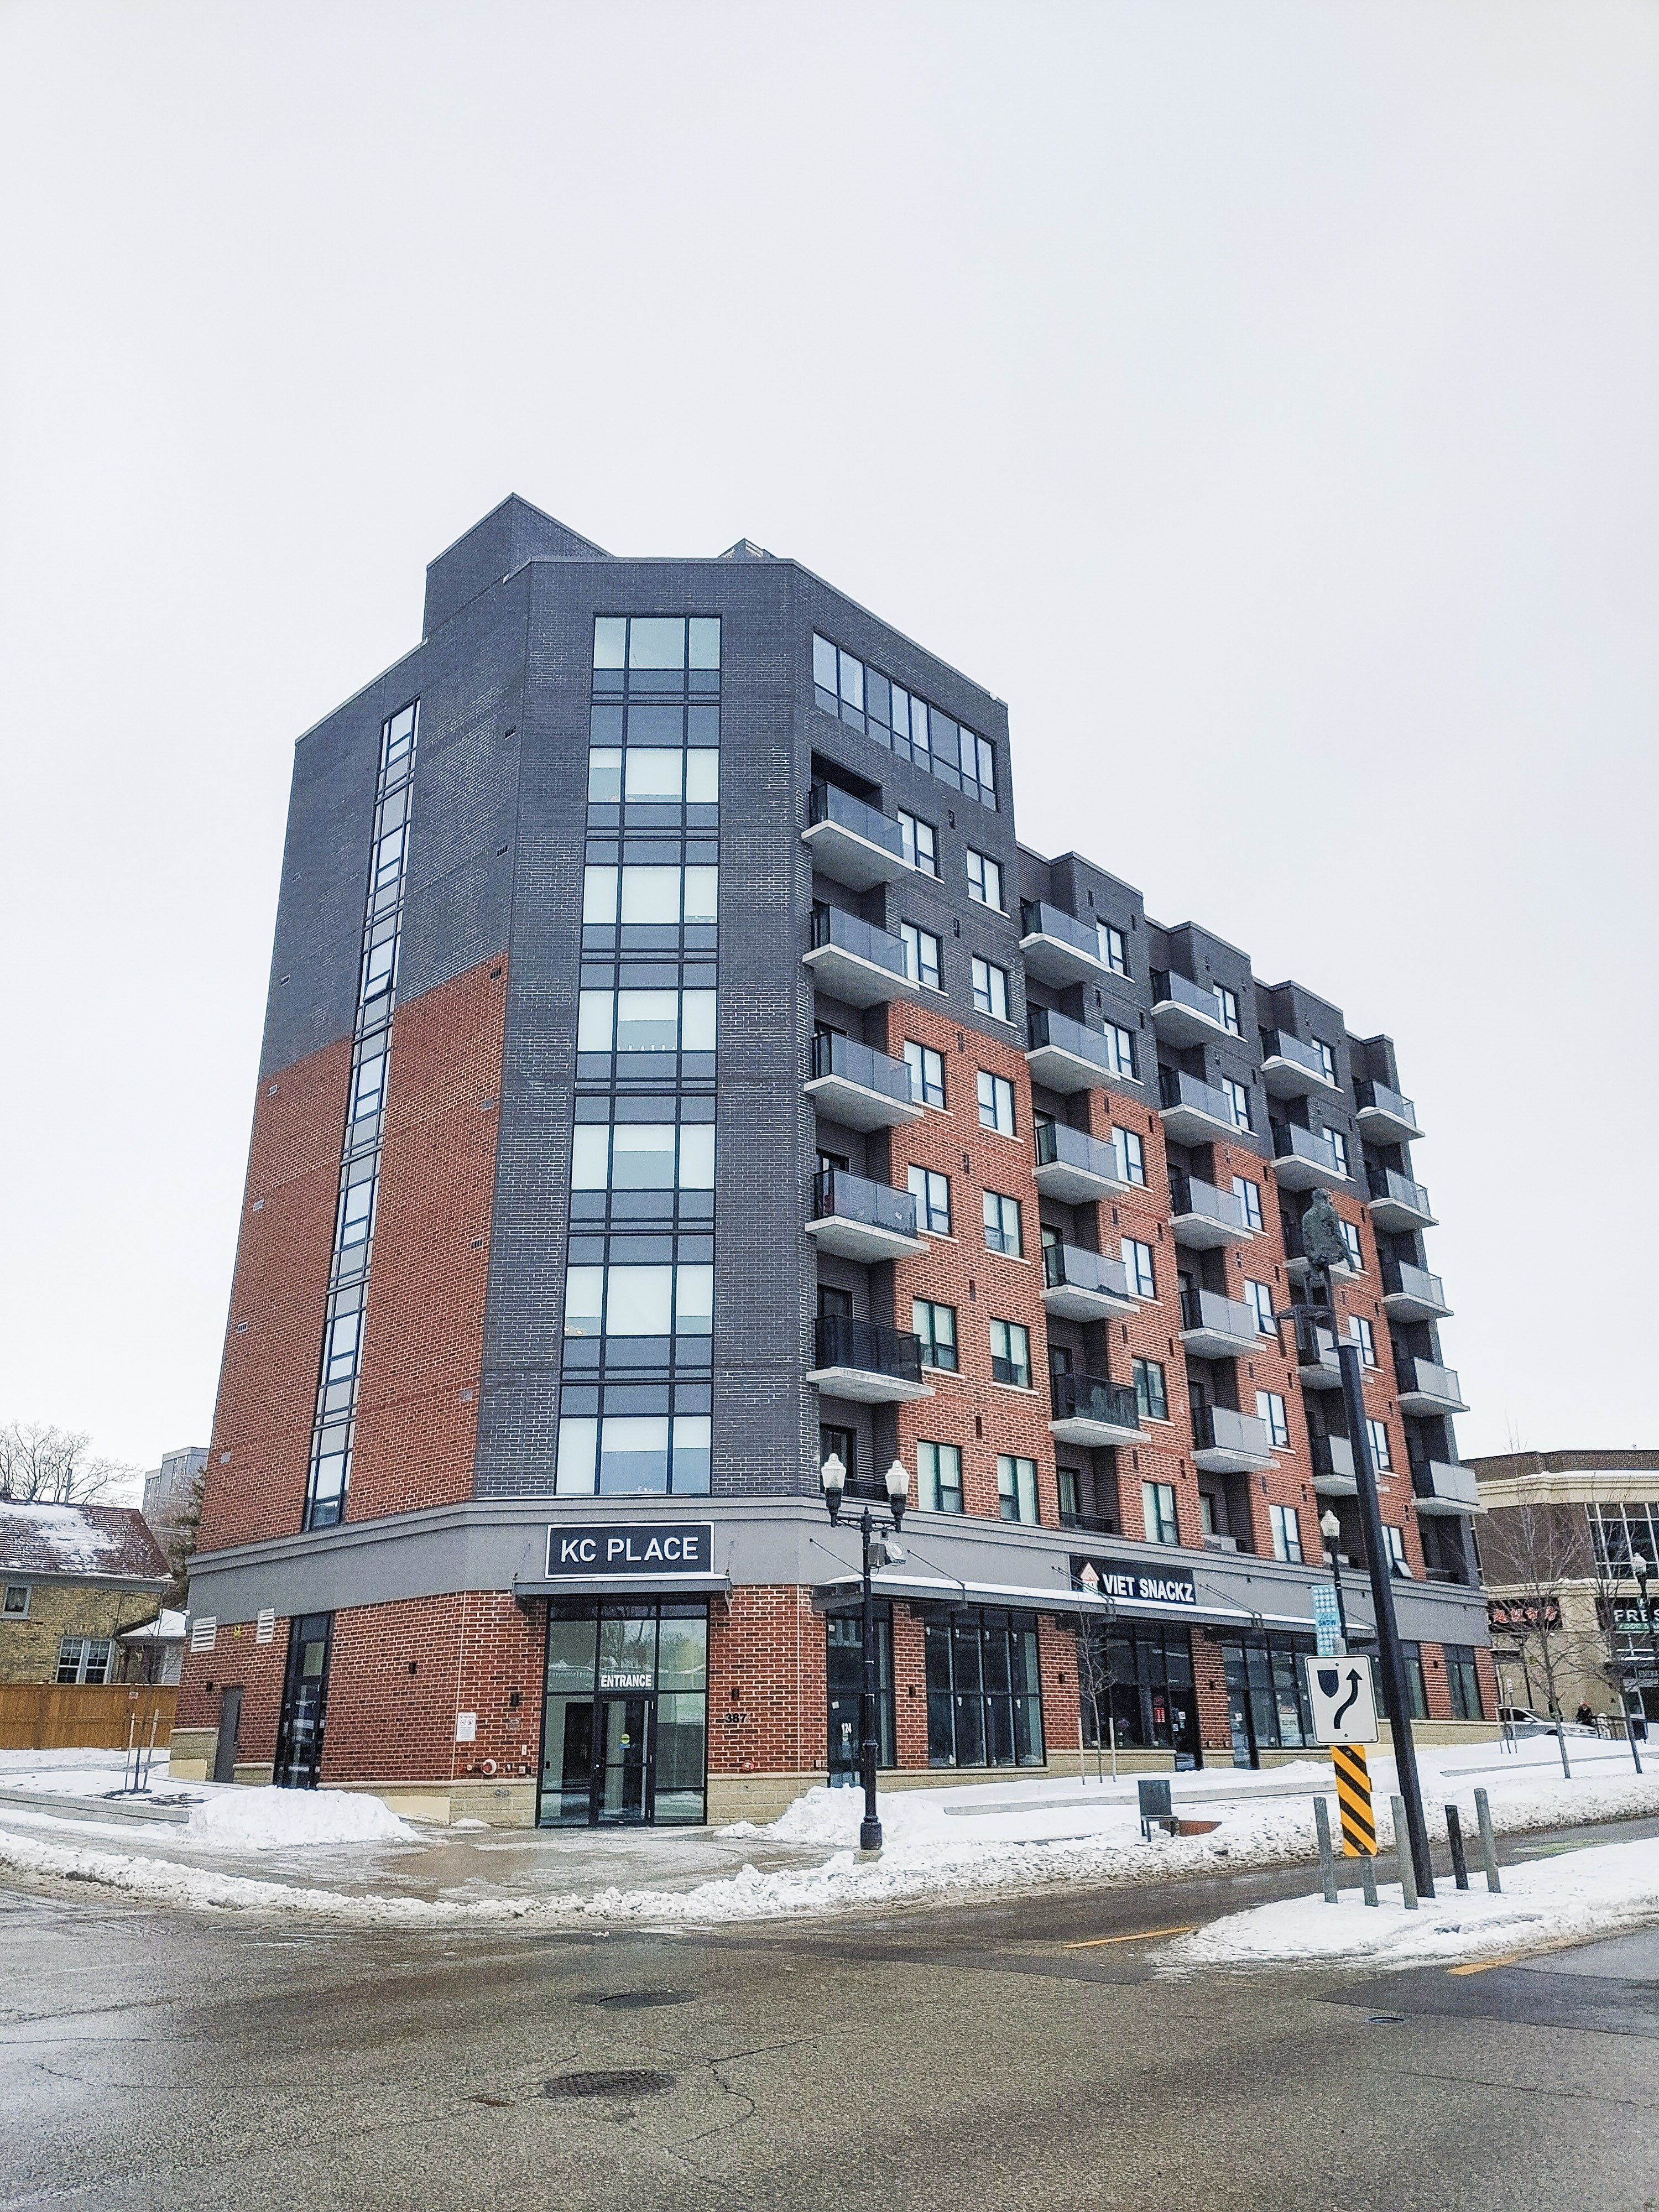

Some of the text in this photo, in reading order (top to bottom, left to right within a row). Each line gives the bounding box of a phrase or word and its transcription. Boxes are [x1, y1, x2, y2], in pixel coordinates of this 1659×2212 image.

[560, 1537, 699, 1562] KC PLACE
[1102, 1573, 1194, 1603] VIET SNACKZ
[601, 1674, 652, 1688] ENTRANCE
[725, 1713, 747, 1723] 387
